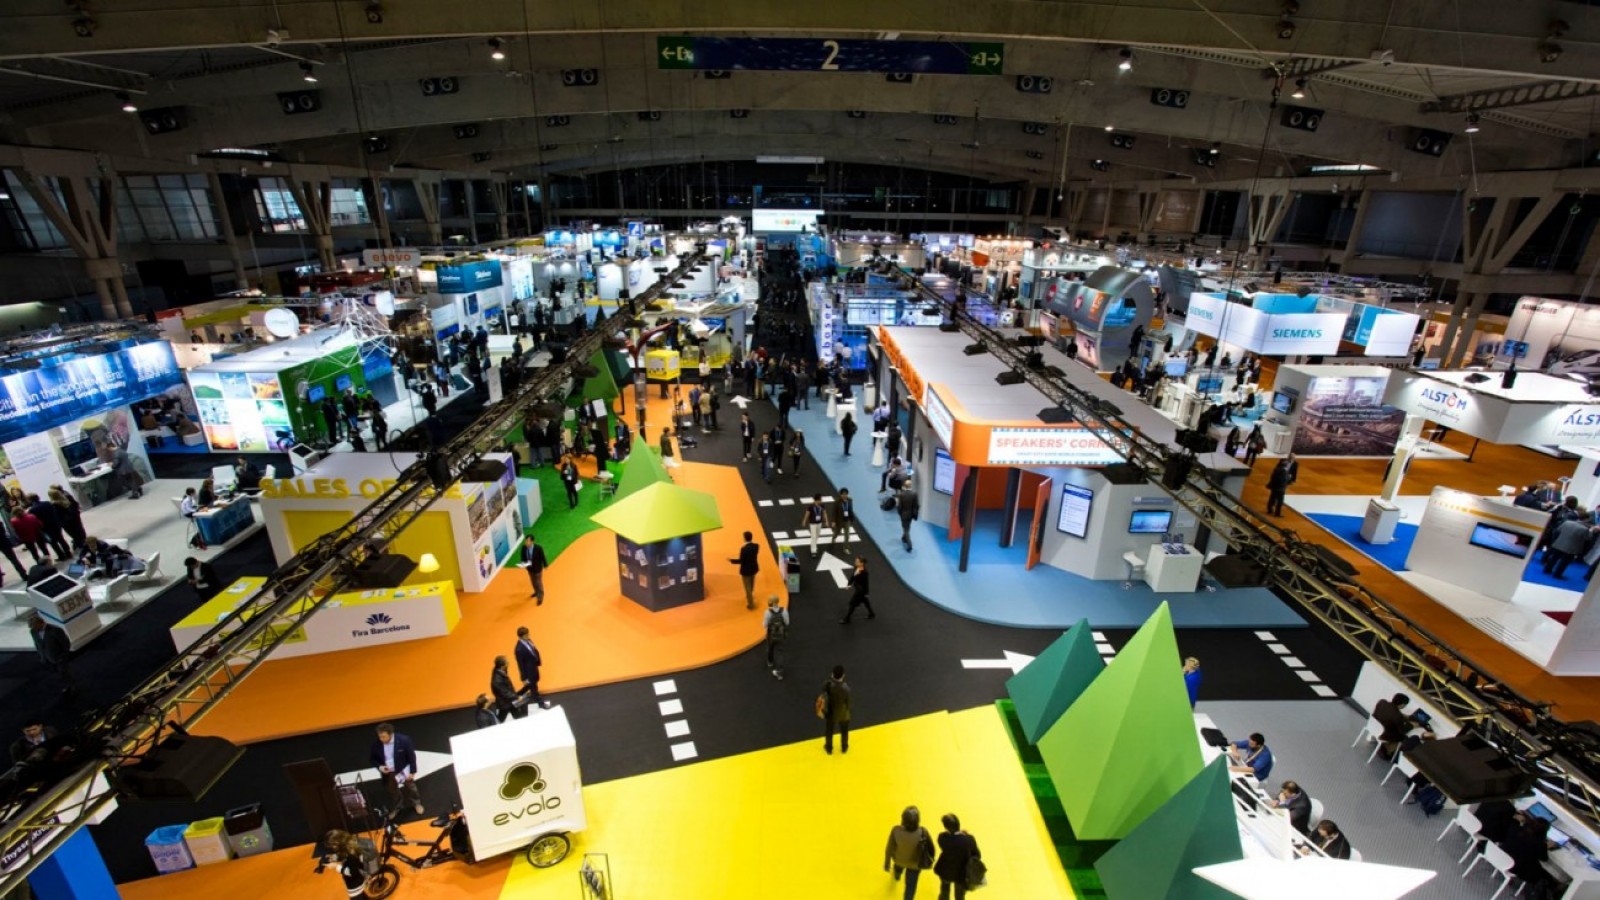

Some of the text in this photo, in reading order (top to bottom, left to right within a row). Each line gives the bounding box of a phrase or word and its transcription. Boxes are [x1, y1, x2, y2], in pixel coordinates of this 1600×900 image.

[821, 41, 840, 70] 2
[1189, 306, 1214, 320] SIEMENS
[823, 303, 833, 358] rbaser
[1272, 328, 1322, 338] SIEMENS
[1421, 388, 1467, 410] ALSTOM
[995, 438, 1121, 450] SPEAKERS' CORNR
[258, 478, 464, 499] SALES OFE
[57, 591, 91, 616] IBM
[352, 624, 410, 638] Fira Barcelona
[493, 794, 561, 826] evolo
[2, 817, 57, 864] ThysseKrup
